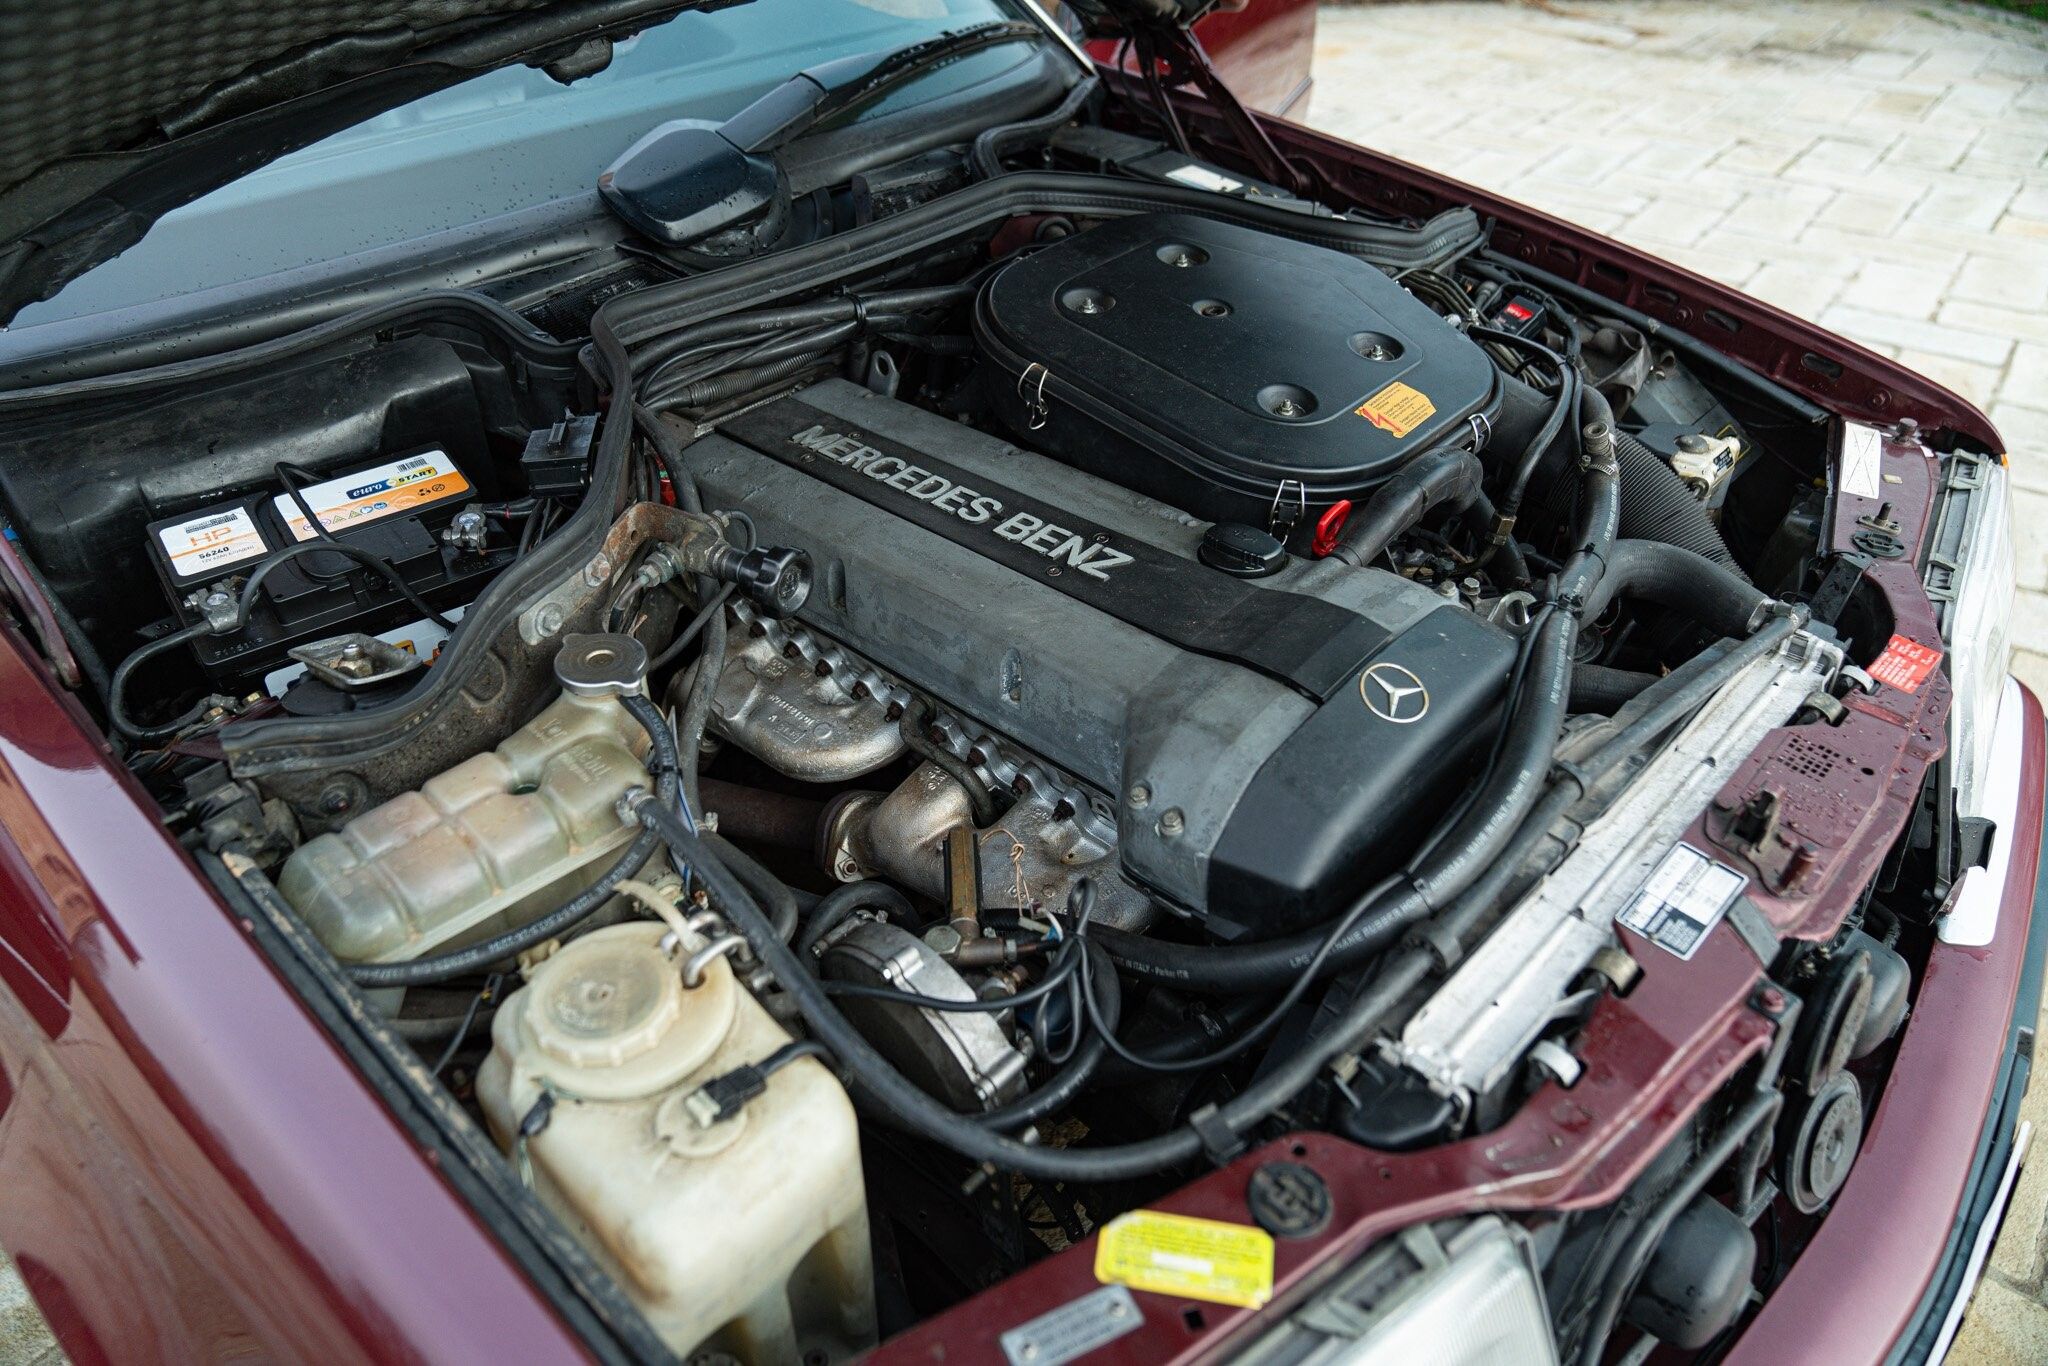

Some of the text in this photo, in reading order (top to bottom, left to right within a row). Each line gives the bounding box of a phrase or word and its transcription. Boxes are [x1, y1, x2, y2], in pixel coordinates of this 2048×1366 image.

[352, 468, 433, 497] euro START
[790, 425, 1135, 581] MERCEDES BENZ
[190, 527, 232, 546] HP
[199, 546, 230, 560] 56240
[1361, 907, 1402, 938] RUBBER
